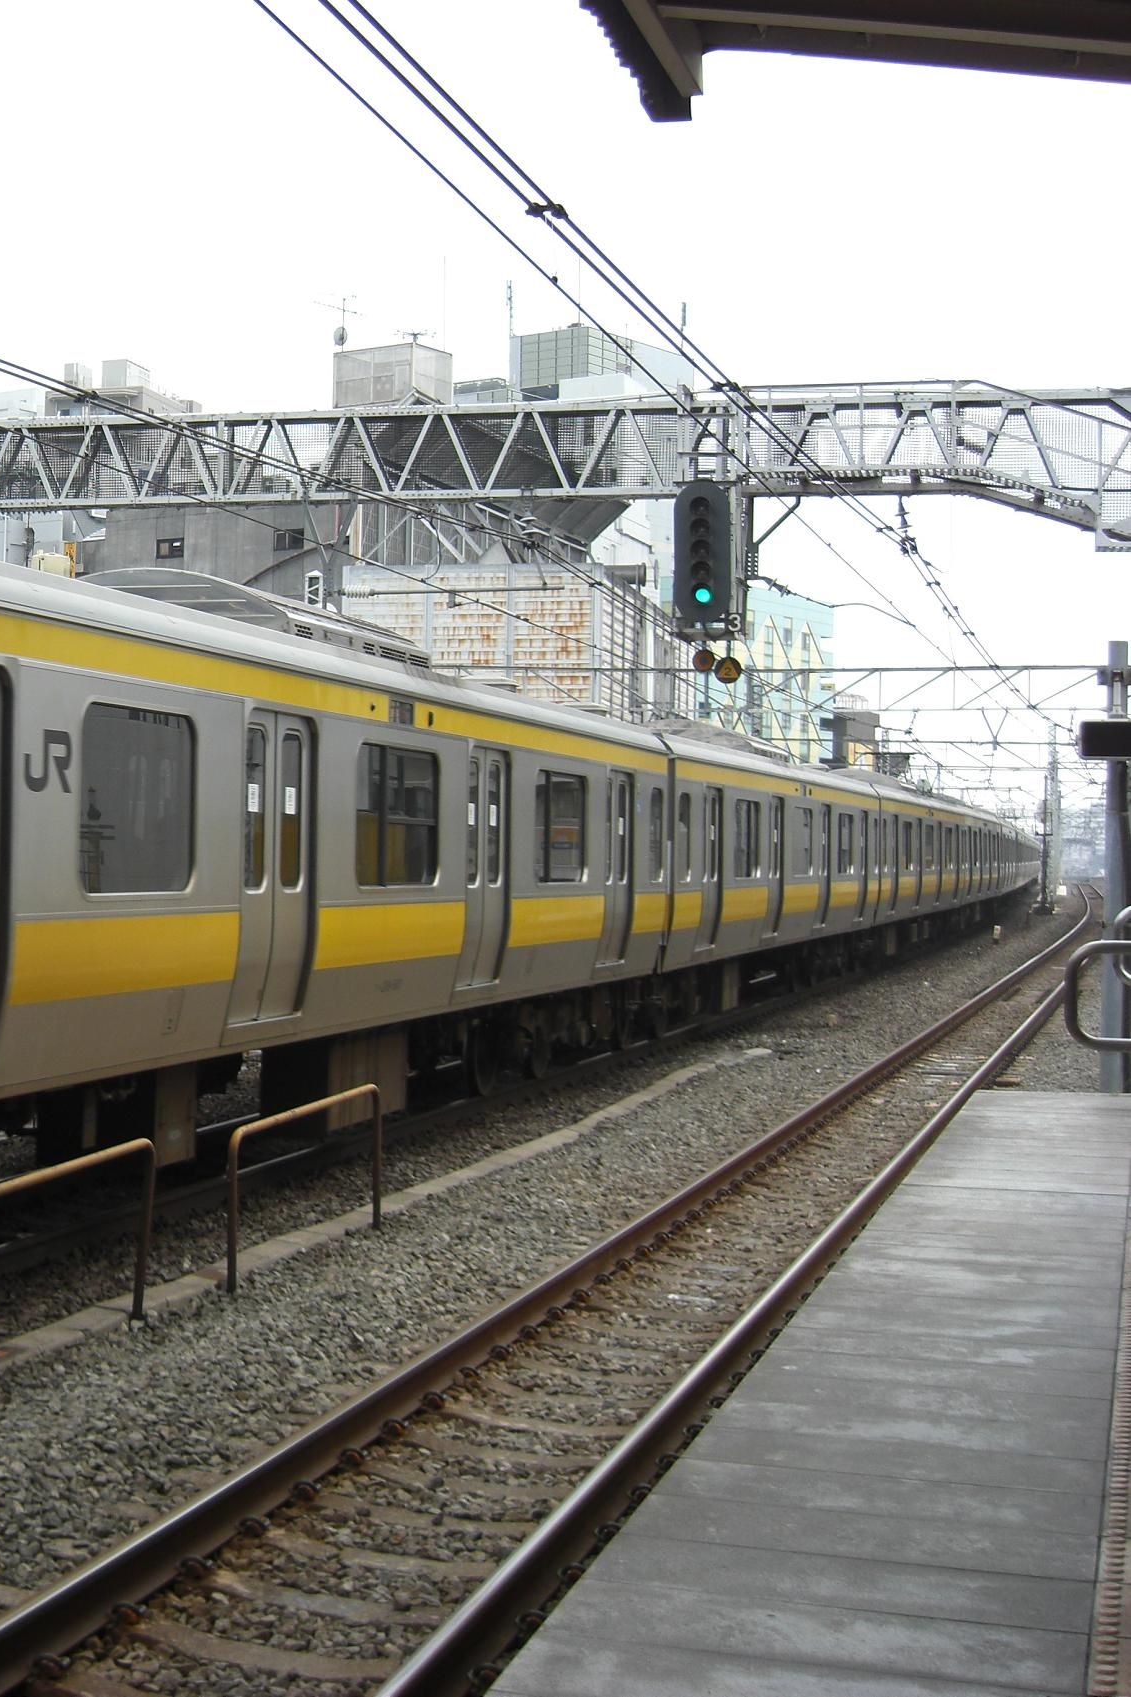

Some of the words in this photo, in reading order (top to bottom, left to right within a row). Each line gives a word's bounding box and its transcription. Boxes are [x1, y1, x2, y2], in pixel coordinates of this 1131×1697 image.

[728, 614, 741, 631] 3
[724, 666, 732, 676] 2
[23, 728, 72, 793] JR
